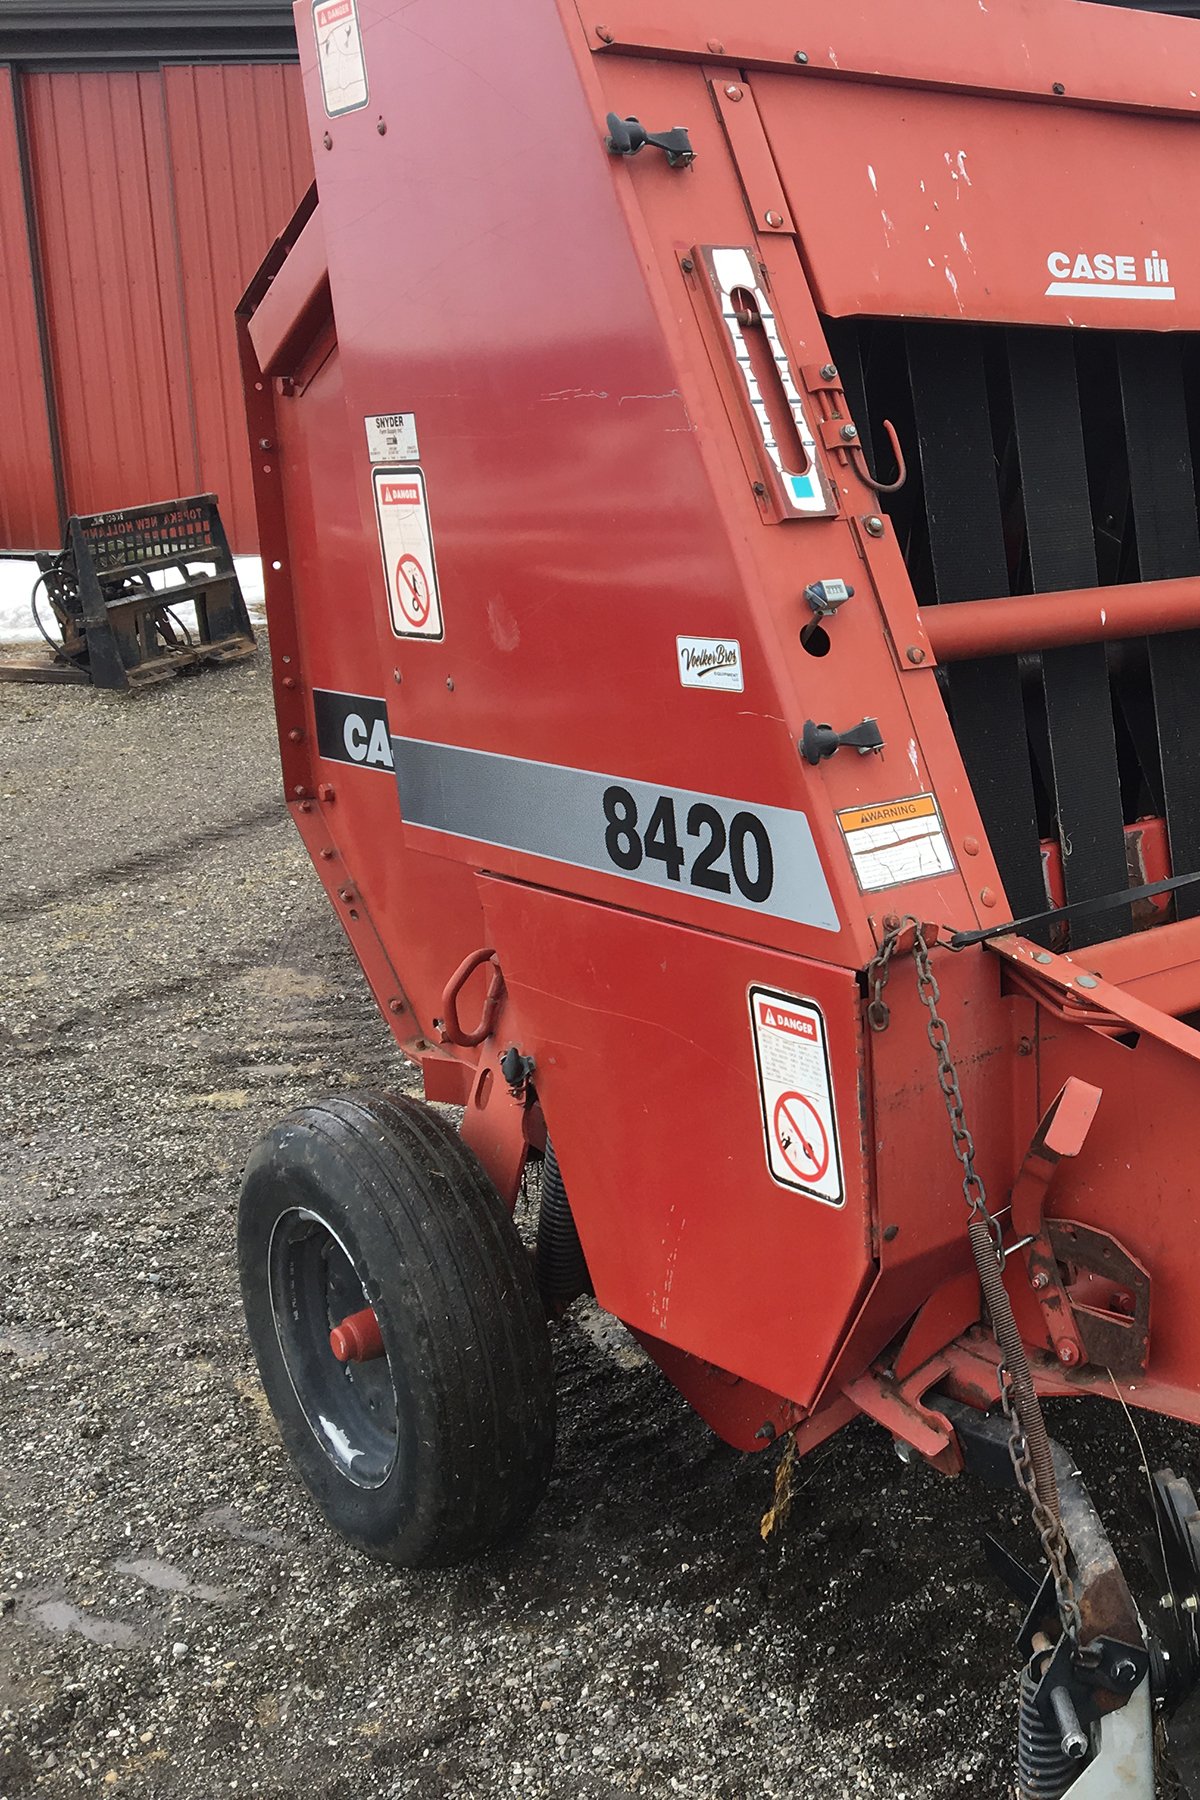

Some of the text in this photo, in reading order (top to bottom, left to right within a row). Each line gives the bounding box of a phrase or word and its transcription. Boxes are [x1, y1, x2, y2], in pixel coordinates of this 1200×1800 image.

[327, 3, 350, 20] DANGER
[1046, 251, 1137, 281] CASE
[375, 416, 404, 428] SNYDER
[392, 489, 417, 500] DANGER
[681, 644, 737, 671] Voelker Bros
[343, 713, 395, 767] CA
[867, 804, 917, 821] WARNING
[602, 785, 774, 903] 8420
[776, 1014, 814, 1035] DANGER
